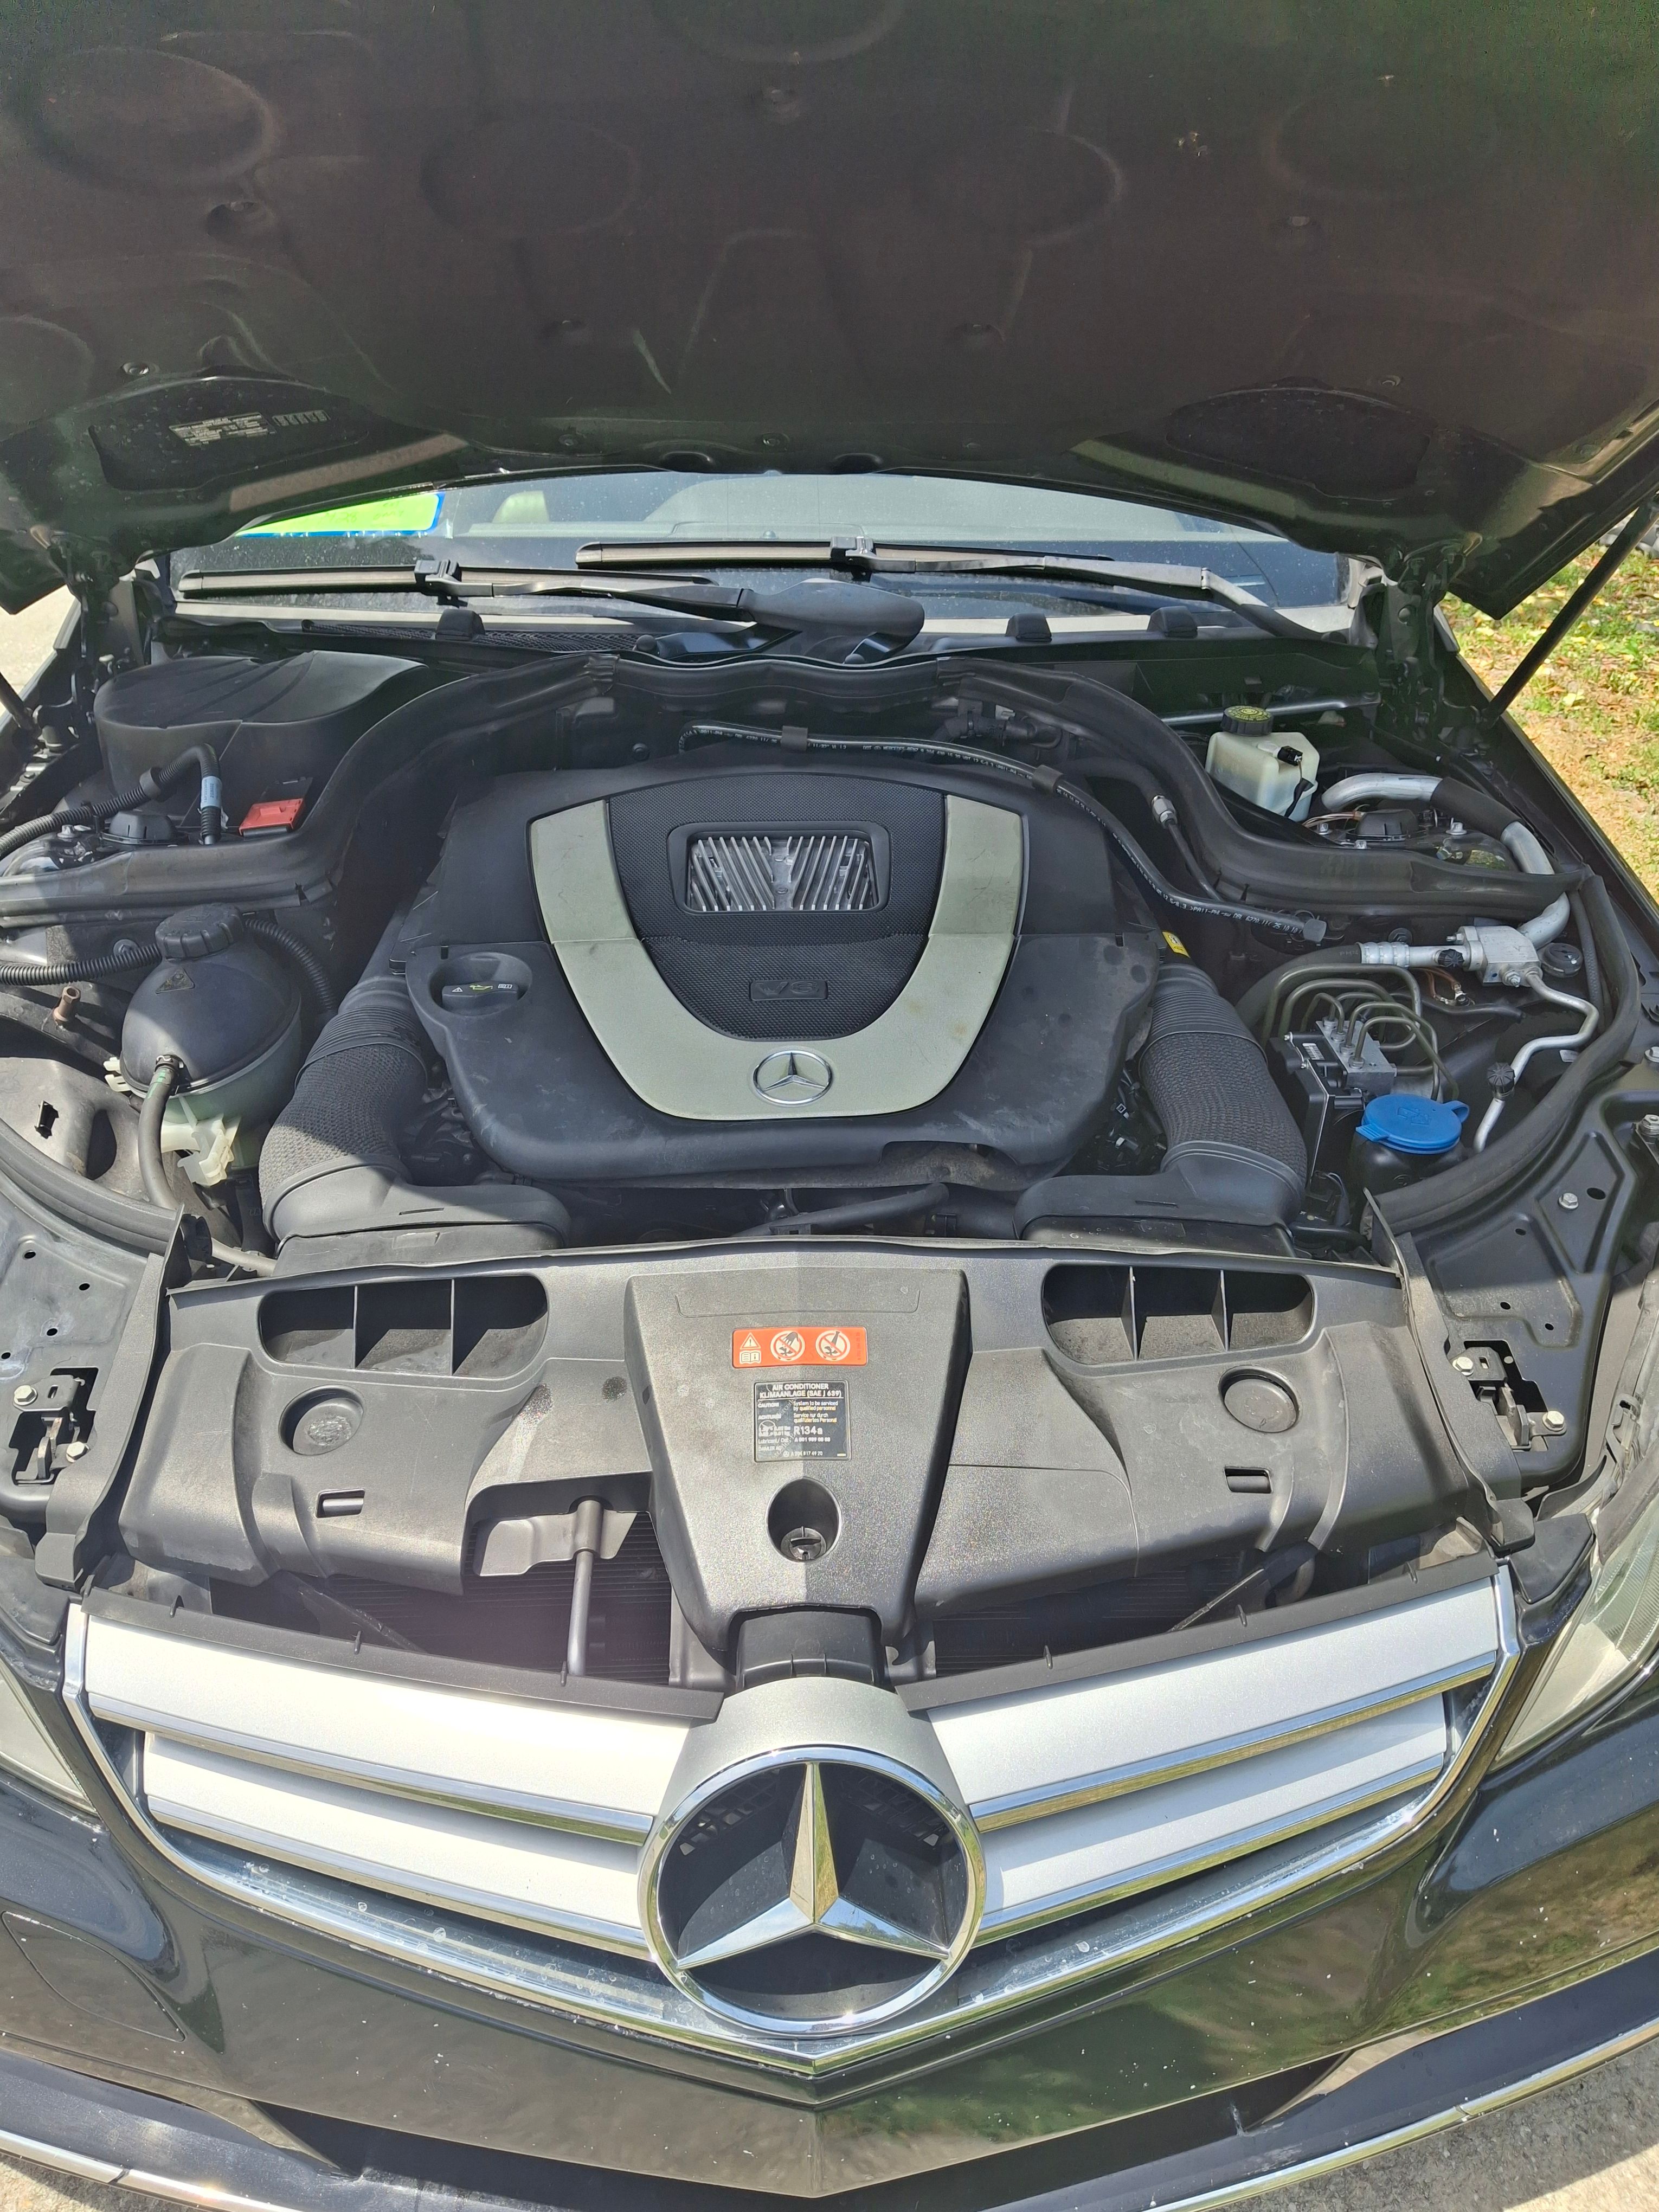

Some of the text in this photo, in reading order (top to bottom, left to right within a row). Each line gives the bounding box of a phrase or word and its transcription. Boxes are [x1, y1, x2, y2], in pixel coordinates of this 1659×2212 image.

[756, 980, 820, 995] V6
[760, 1390, 806, 1399] KLIMAANLAGE
[793, 1425, 823, 1435] R134a
